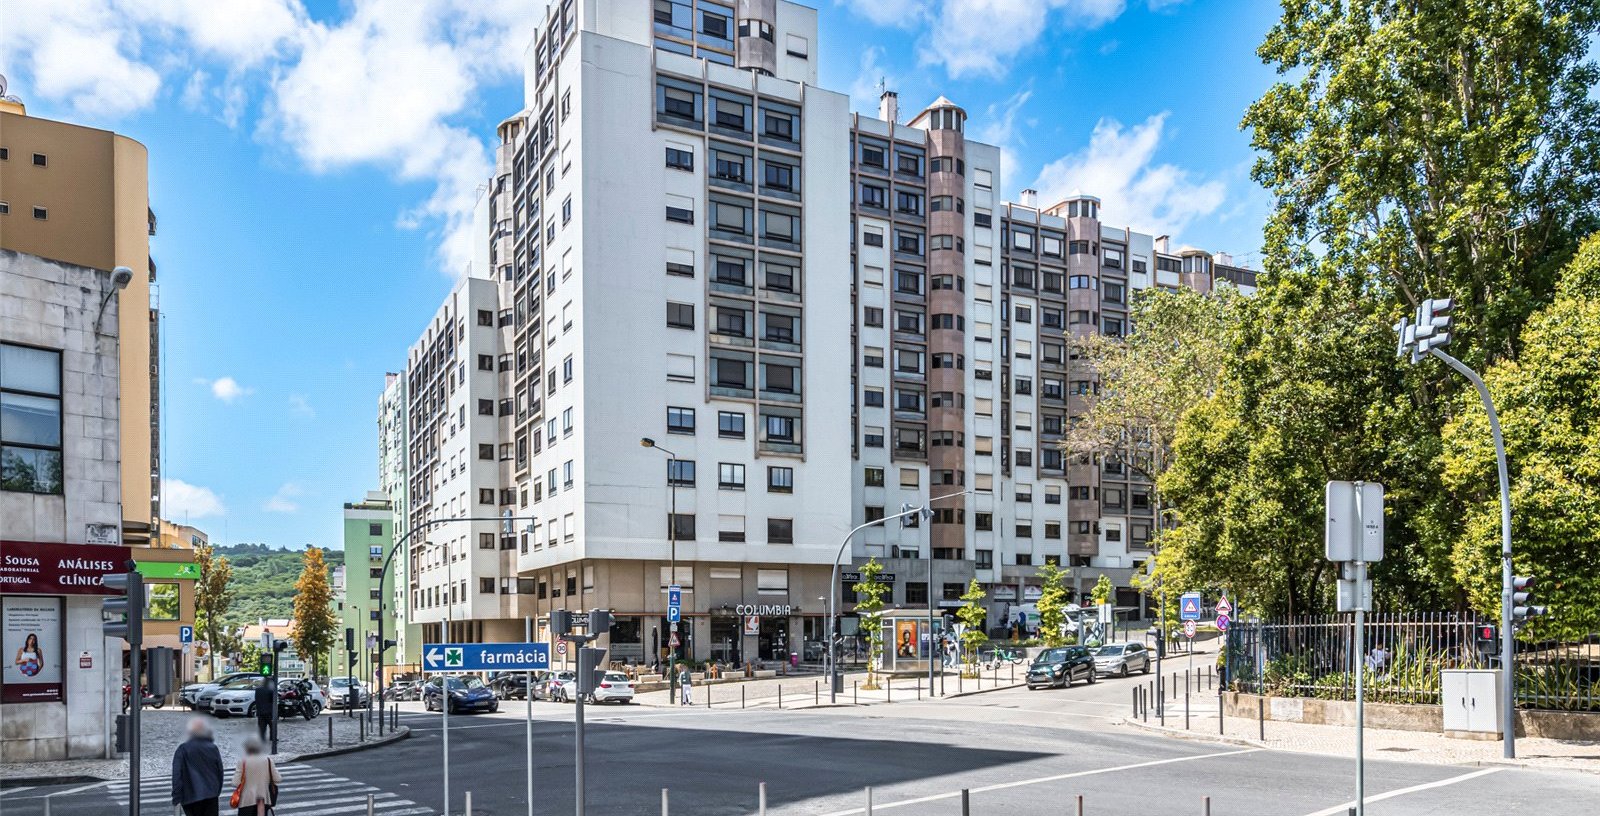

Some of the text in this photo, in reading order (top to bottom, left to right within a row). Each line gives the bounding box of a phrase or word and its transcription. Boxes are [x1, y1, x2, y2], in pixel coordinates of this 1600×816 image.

[58, 557, 114, 571] ANÁLISES
[0, 576, 31, 584] ORTUGAL
[59, 573, 104, 586] CLÍNICA
[670, 607, 678, 620] P
[736, 604, 791, 616] COLUMBIA
[182, 627, 191, 642] P
[480, 649, 547, 664] farmácia
